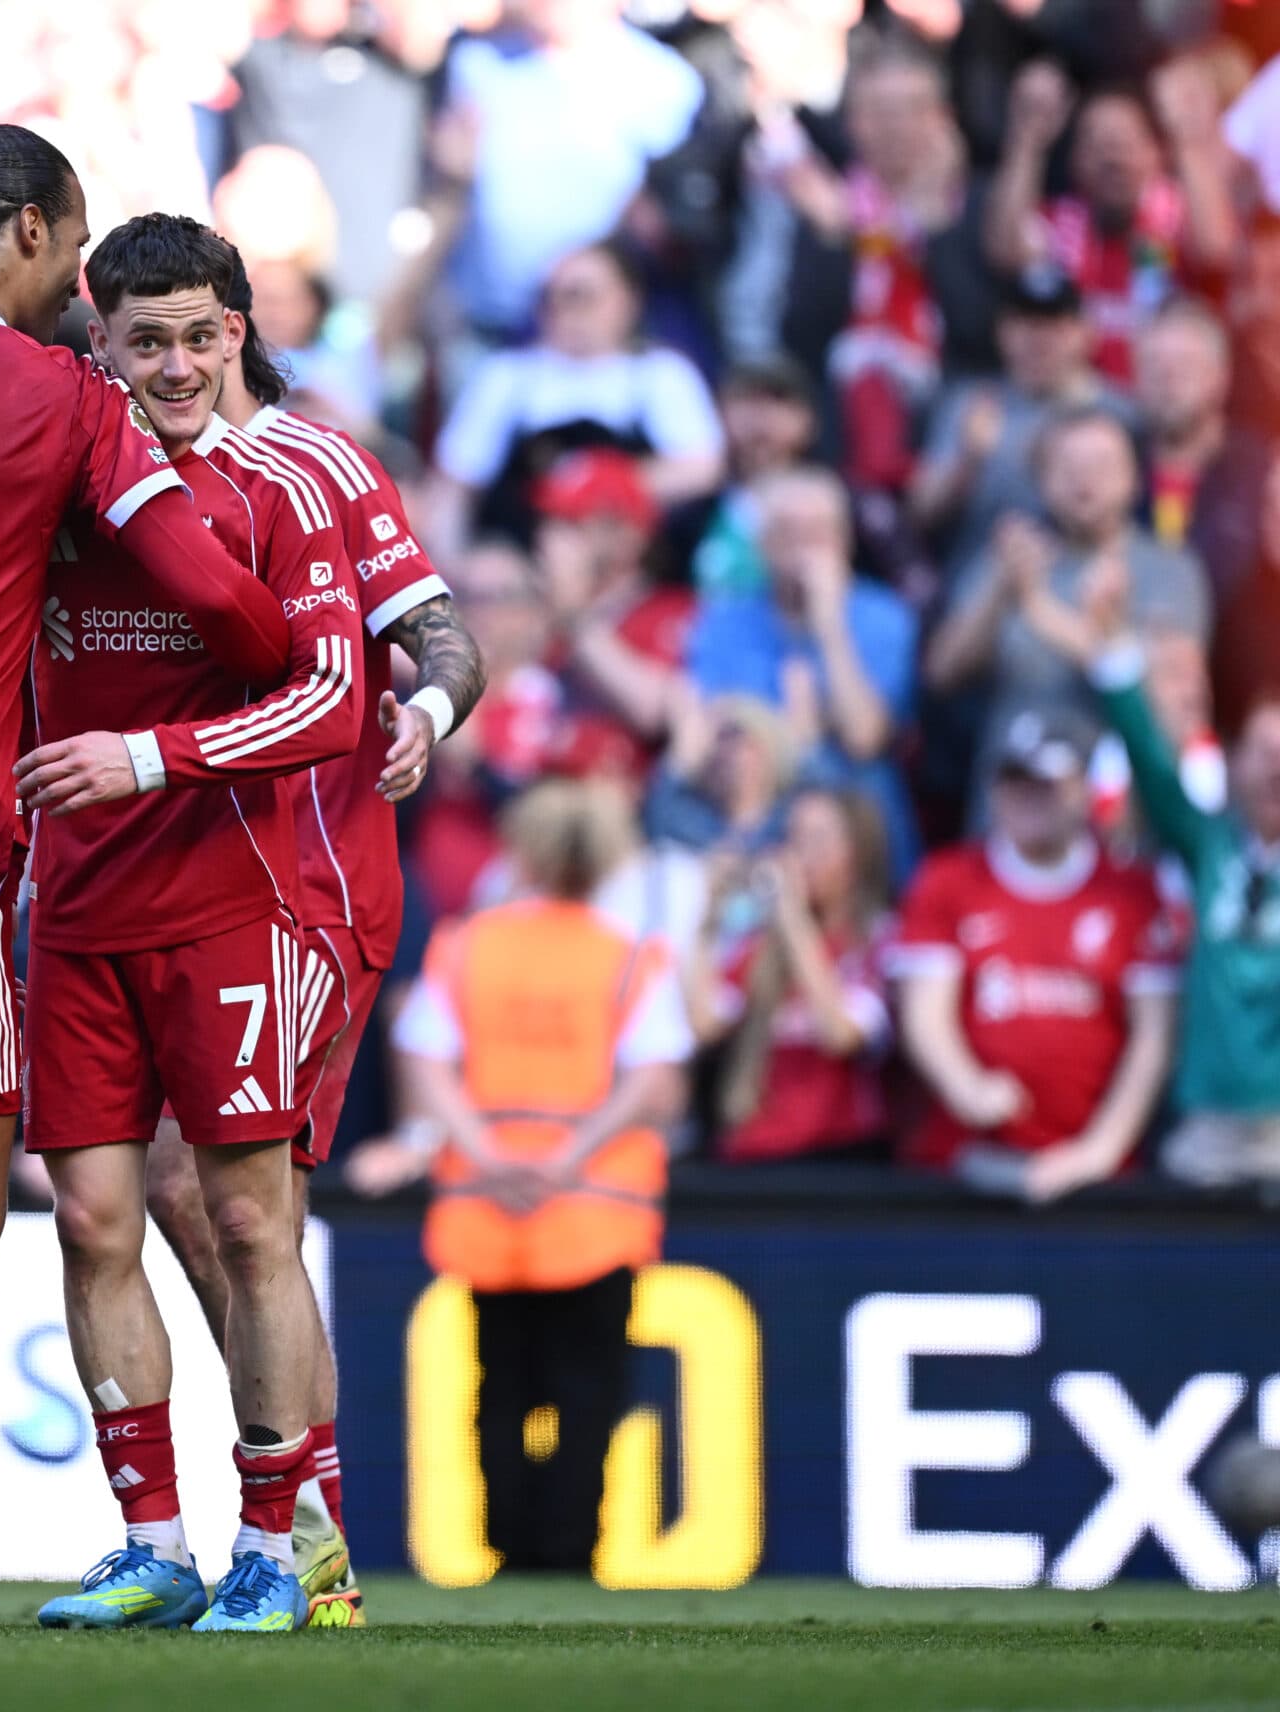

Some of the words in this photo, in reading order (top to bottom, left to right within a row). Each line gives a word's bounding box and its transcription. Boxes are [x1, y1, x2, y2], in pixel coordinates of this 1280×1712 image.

[219, 983, 268, 1068] 7
[95, 1422, 140, 1443] LFC
[841, 1291, 1280, 1592] Ex
